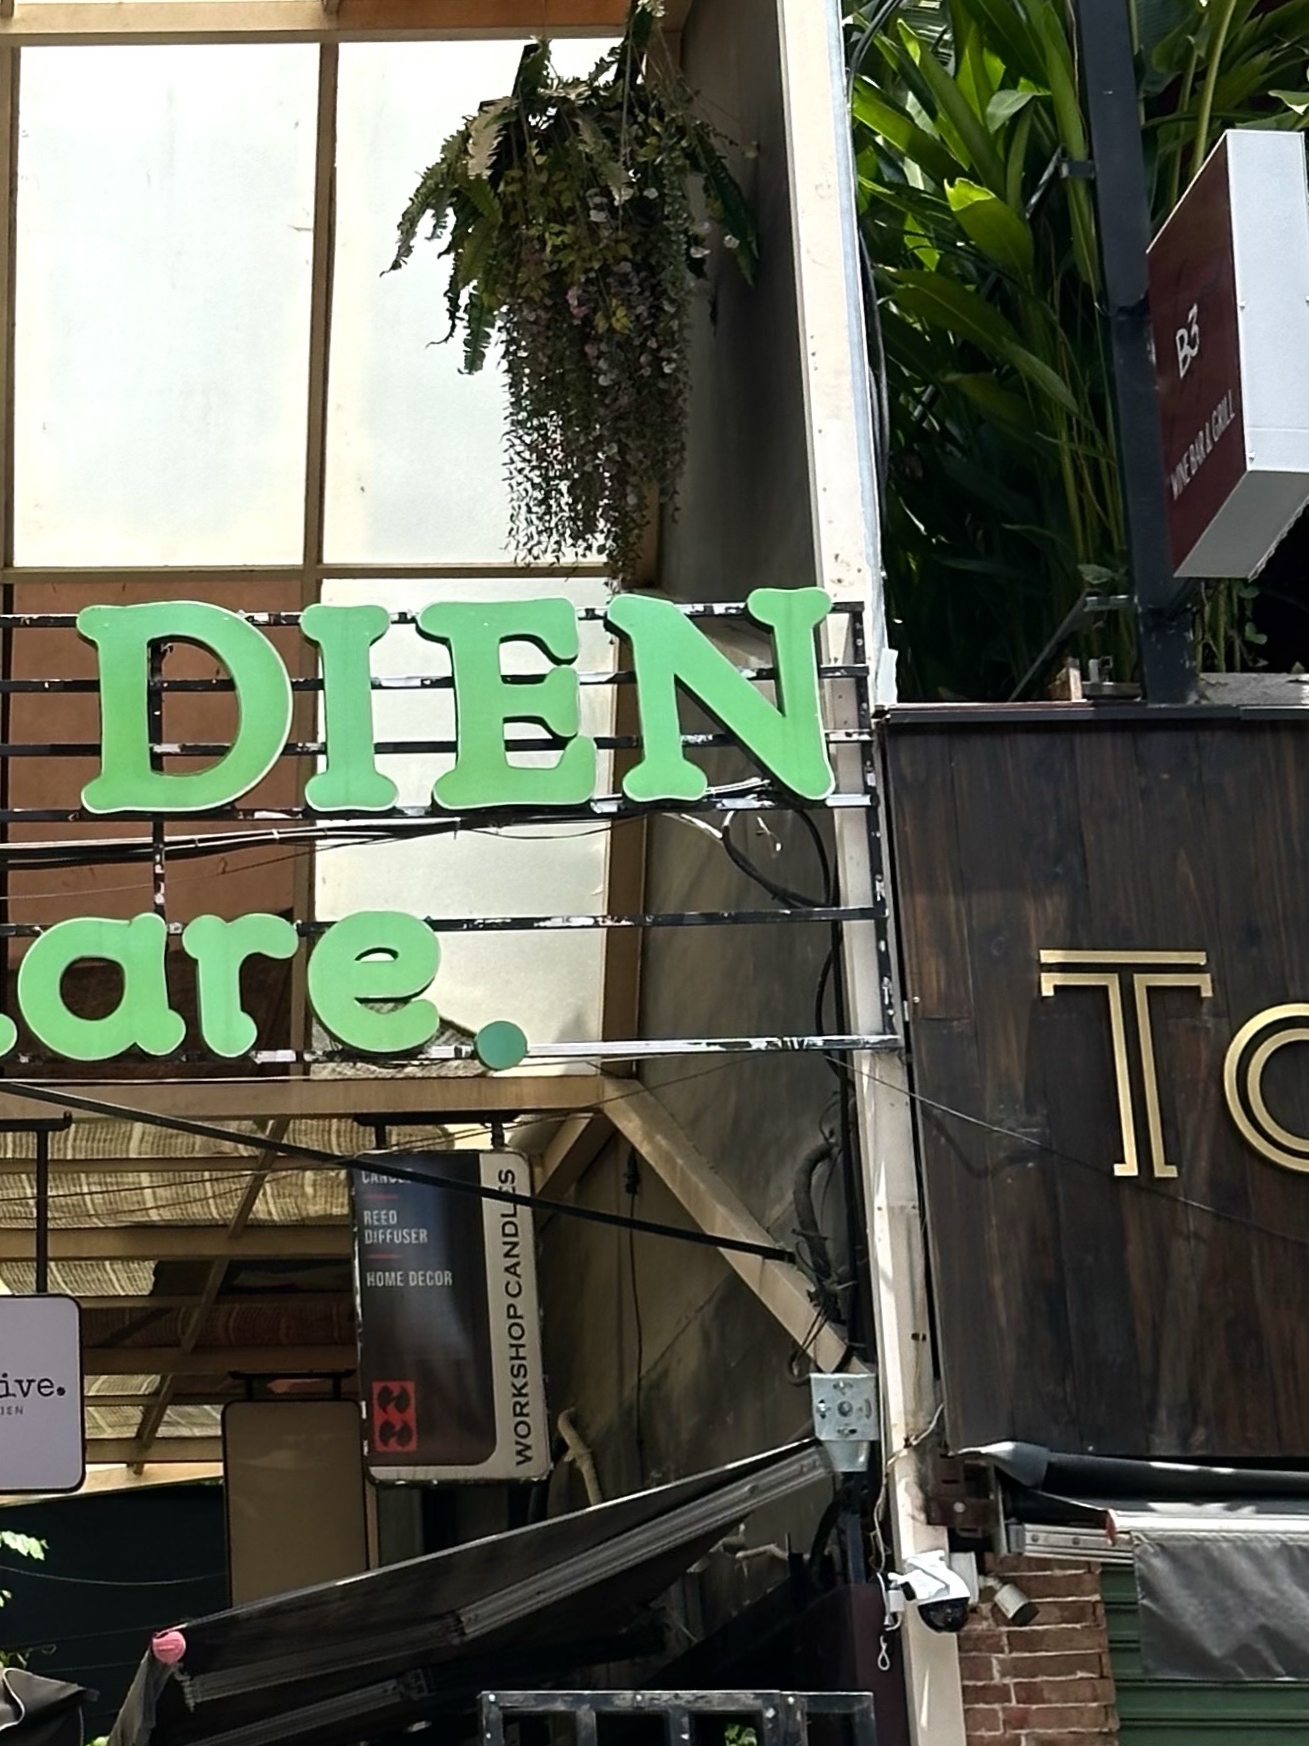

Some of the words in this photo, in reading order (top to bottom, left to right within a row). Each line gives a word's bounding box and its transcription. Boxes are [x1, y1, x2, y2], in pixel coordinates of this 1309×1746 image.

[77, 586, 837, 816] DIEN
[363, 1210, 397, 1226] REED
[364, 1228, 428, 1245] DIFFUSER
[366, 1270, 405, 1287] HOME
[409, 1270, 453, 1287] DECOR
[505, 1302, 533, 1467] WORKSHOP
